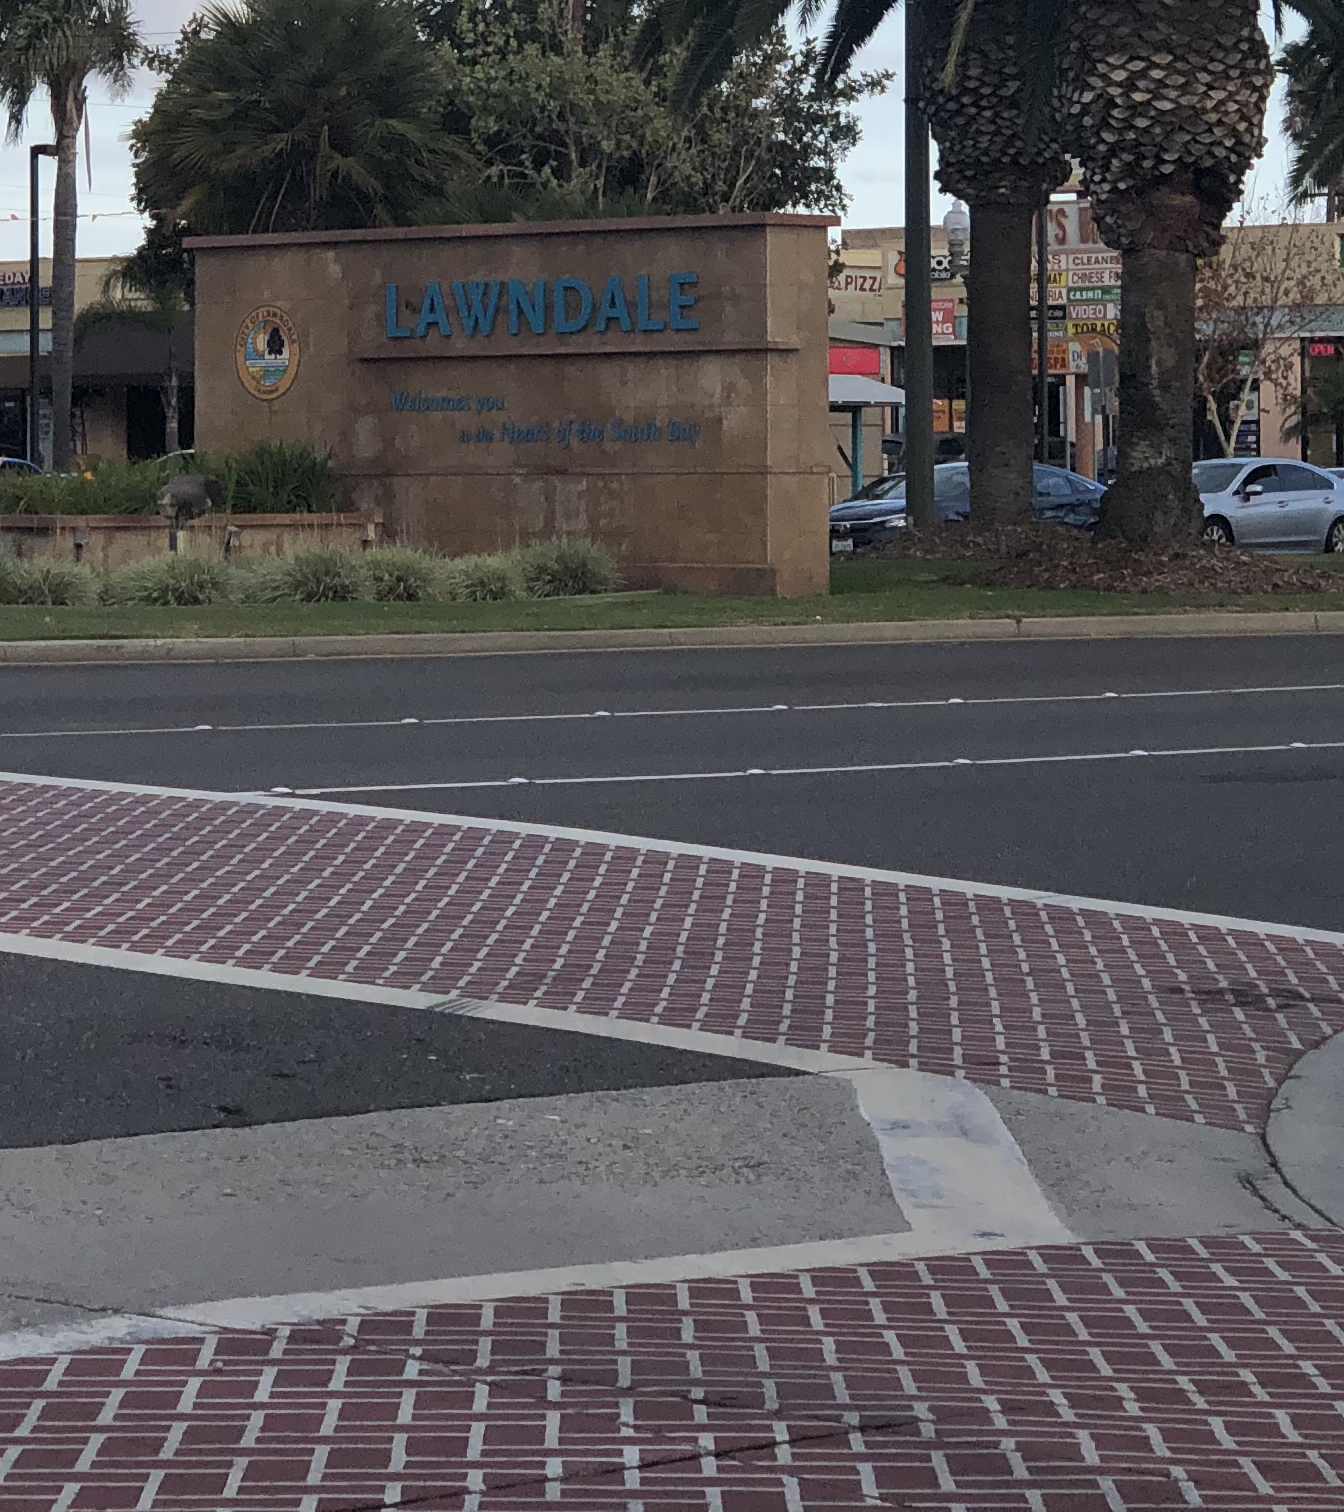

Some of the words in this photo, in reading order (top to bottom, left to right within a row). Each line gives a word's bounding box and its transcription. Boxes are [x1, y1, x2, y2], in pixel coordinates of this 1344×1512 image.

[1071, 271, 1105, 285] CHINESE
[385, 271, 700, 338] LAWNDALE
[1069, 304, 1104, 318] VIDEO
[1309, 343, 1335, 357] OPEN
[477, 394, 505, 415] you
